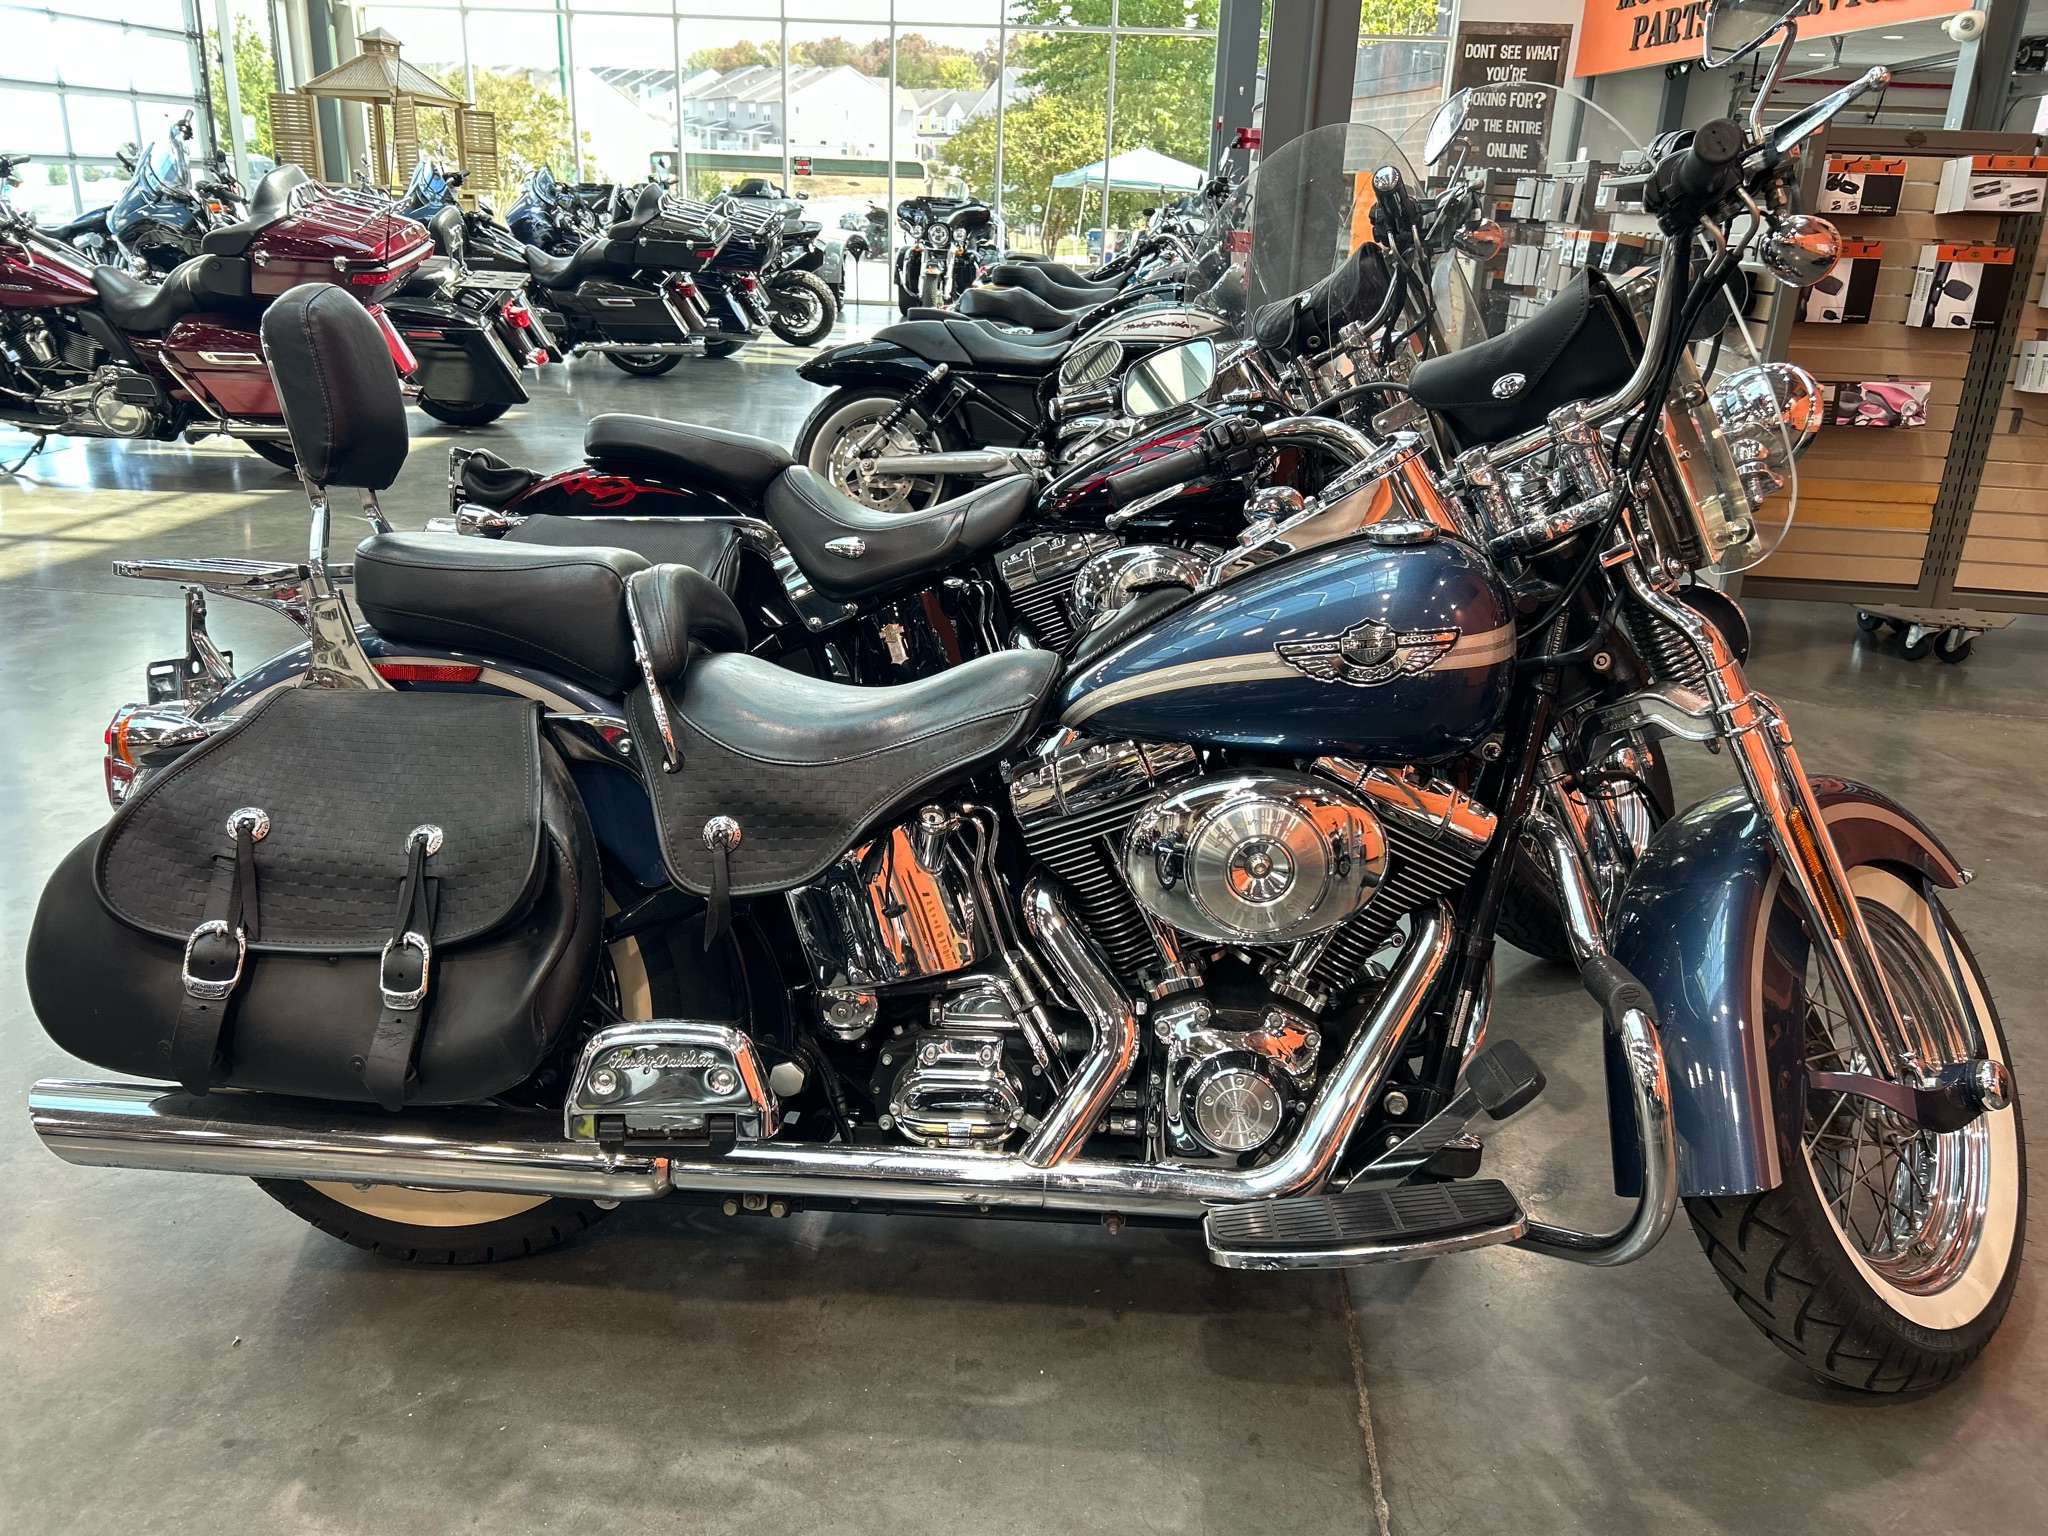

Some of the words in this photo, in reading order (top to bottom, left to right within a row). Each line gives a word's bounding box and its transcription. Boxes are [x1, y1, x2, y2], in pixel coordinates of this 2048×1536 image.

[1629, 0, 1709, 51] PARTS
[1465, 43, 1497, 59] DONT
[1500, 44, 1522, 60] SEE
[1525, 45, 1560, 61] WHAT
[1486, 64, 1528, 82] YOU'RE
[1469, 91, 1507, 107] OKING
[1509, 91, 1547, 110] FOR?
[1461, 118, 1480, 132] OP
[1483, 118, 1504, 133] THE
[1506, 119, 1542, 135] ENTIRE
[1486, 142, 1528, 160] ONLINE
[608, 1050, 719, 1074] Harley-Davidson
